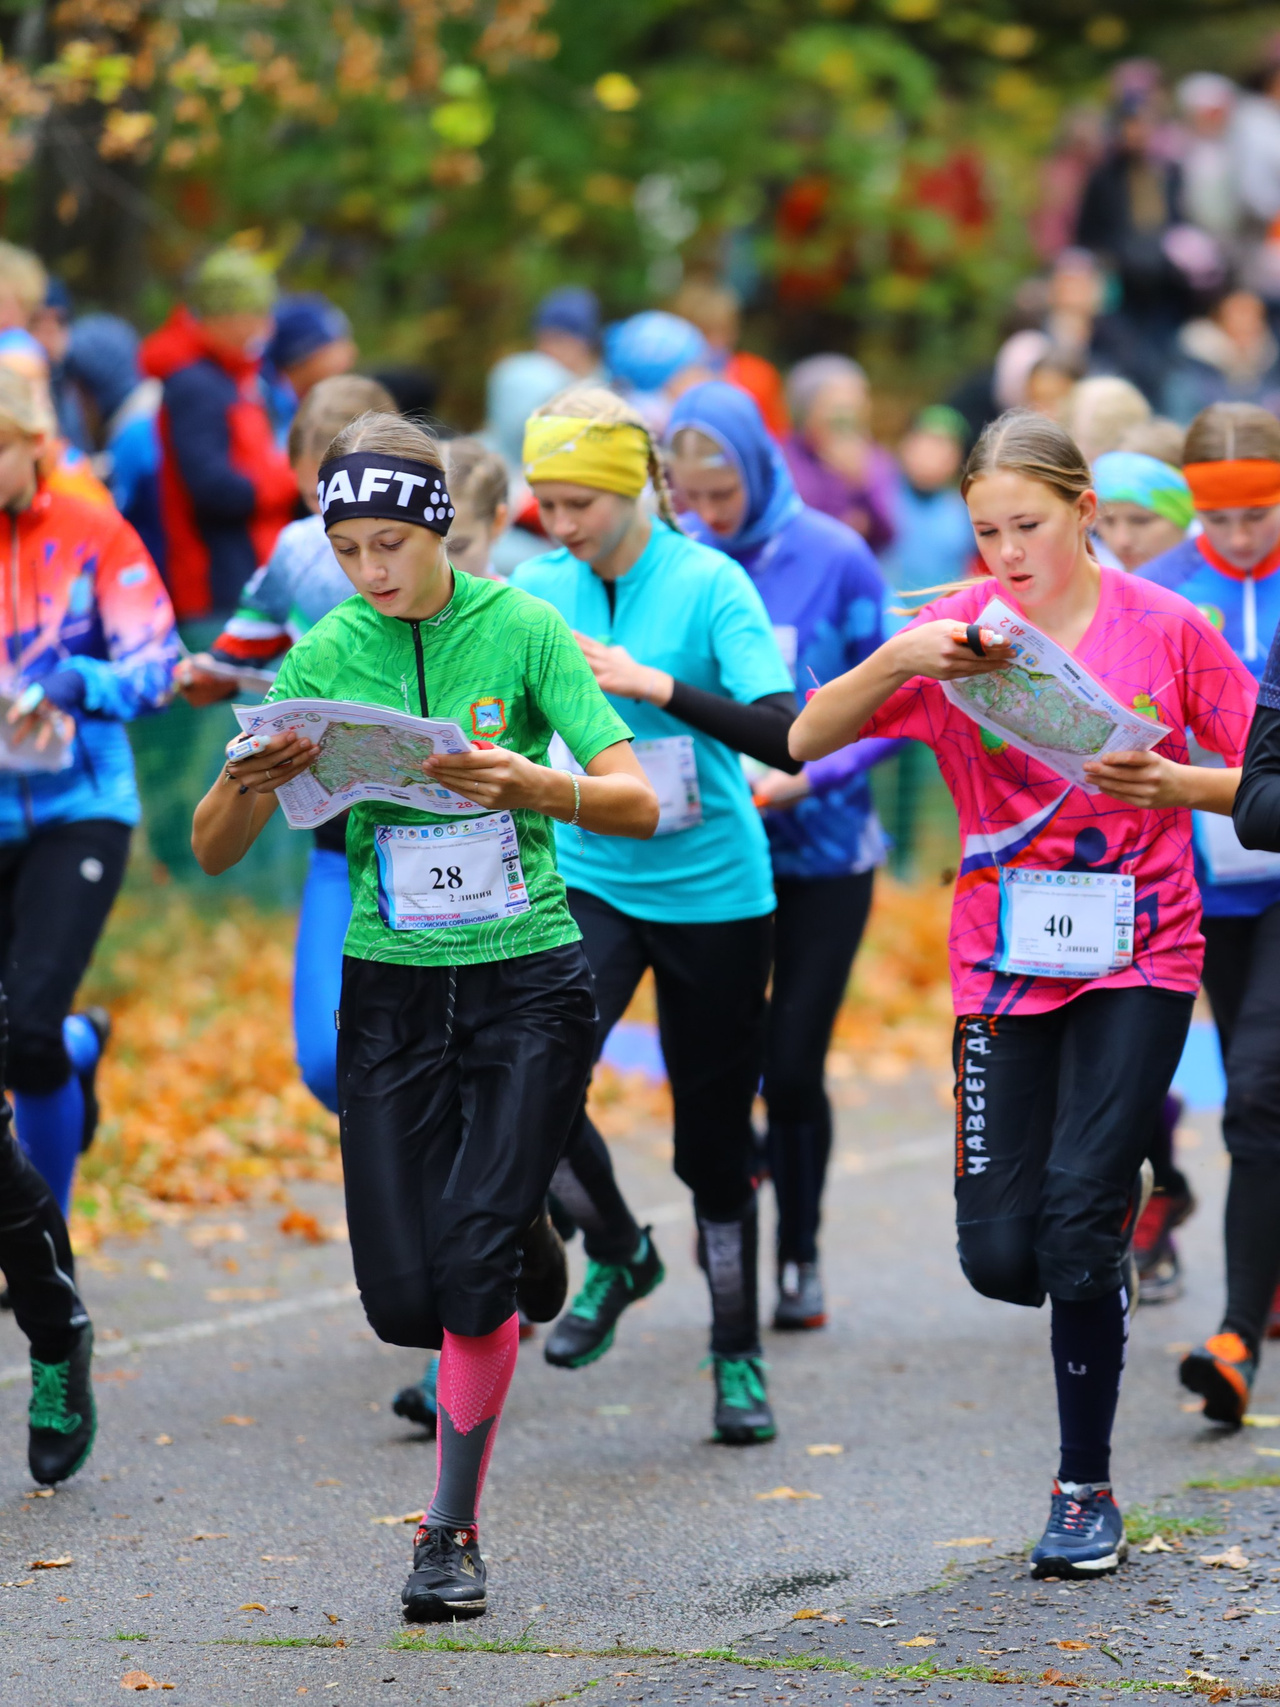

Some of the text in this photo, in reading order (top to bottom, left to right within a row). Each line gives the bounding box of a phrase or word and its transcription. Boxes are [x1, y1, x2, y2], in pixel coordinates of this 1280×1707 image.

[1000, 617, 1026, 637] 40.2
[341, 790, 361, 800] evo
[455, 801, 479, 809] 28.
[429, 865, 463, 890] 28
[450, 894, 455, 903] 2
[458, 890, 492, 902] линия
[448, 913, 499, 926] СОРЕВНОВАНИЯ
[1044, 914, 1073, 938] 40
[1057, 943, 1062, 952] 2
[1065, 945, 1099, 953] линия
[965, 1022, 992, 1175] НАВСЕГДА
